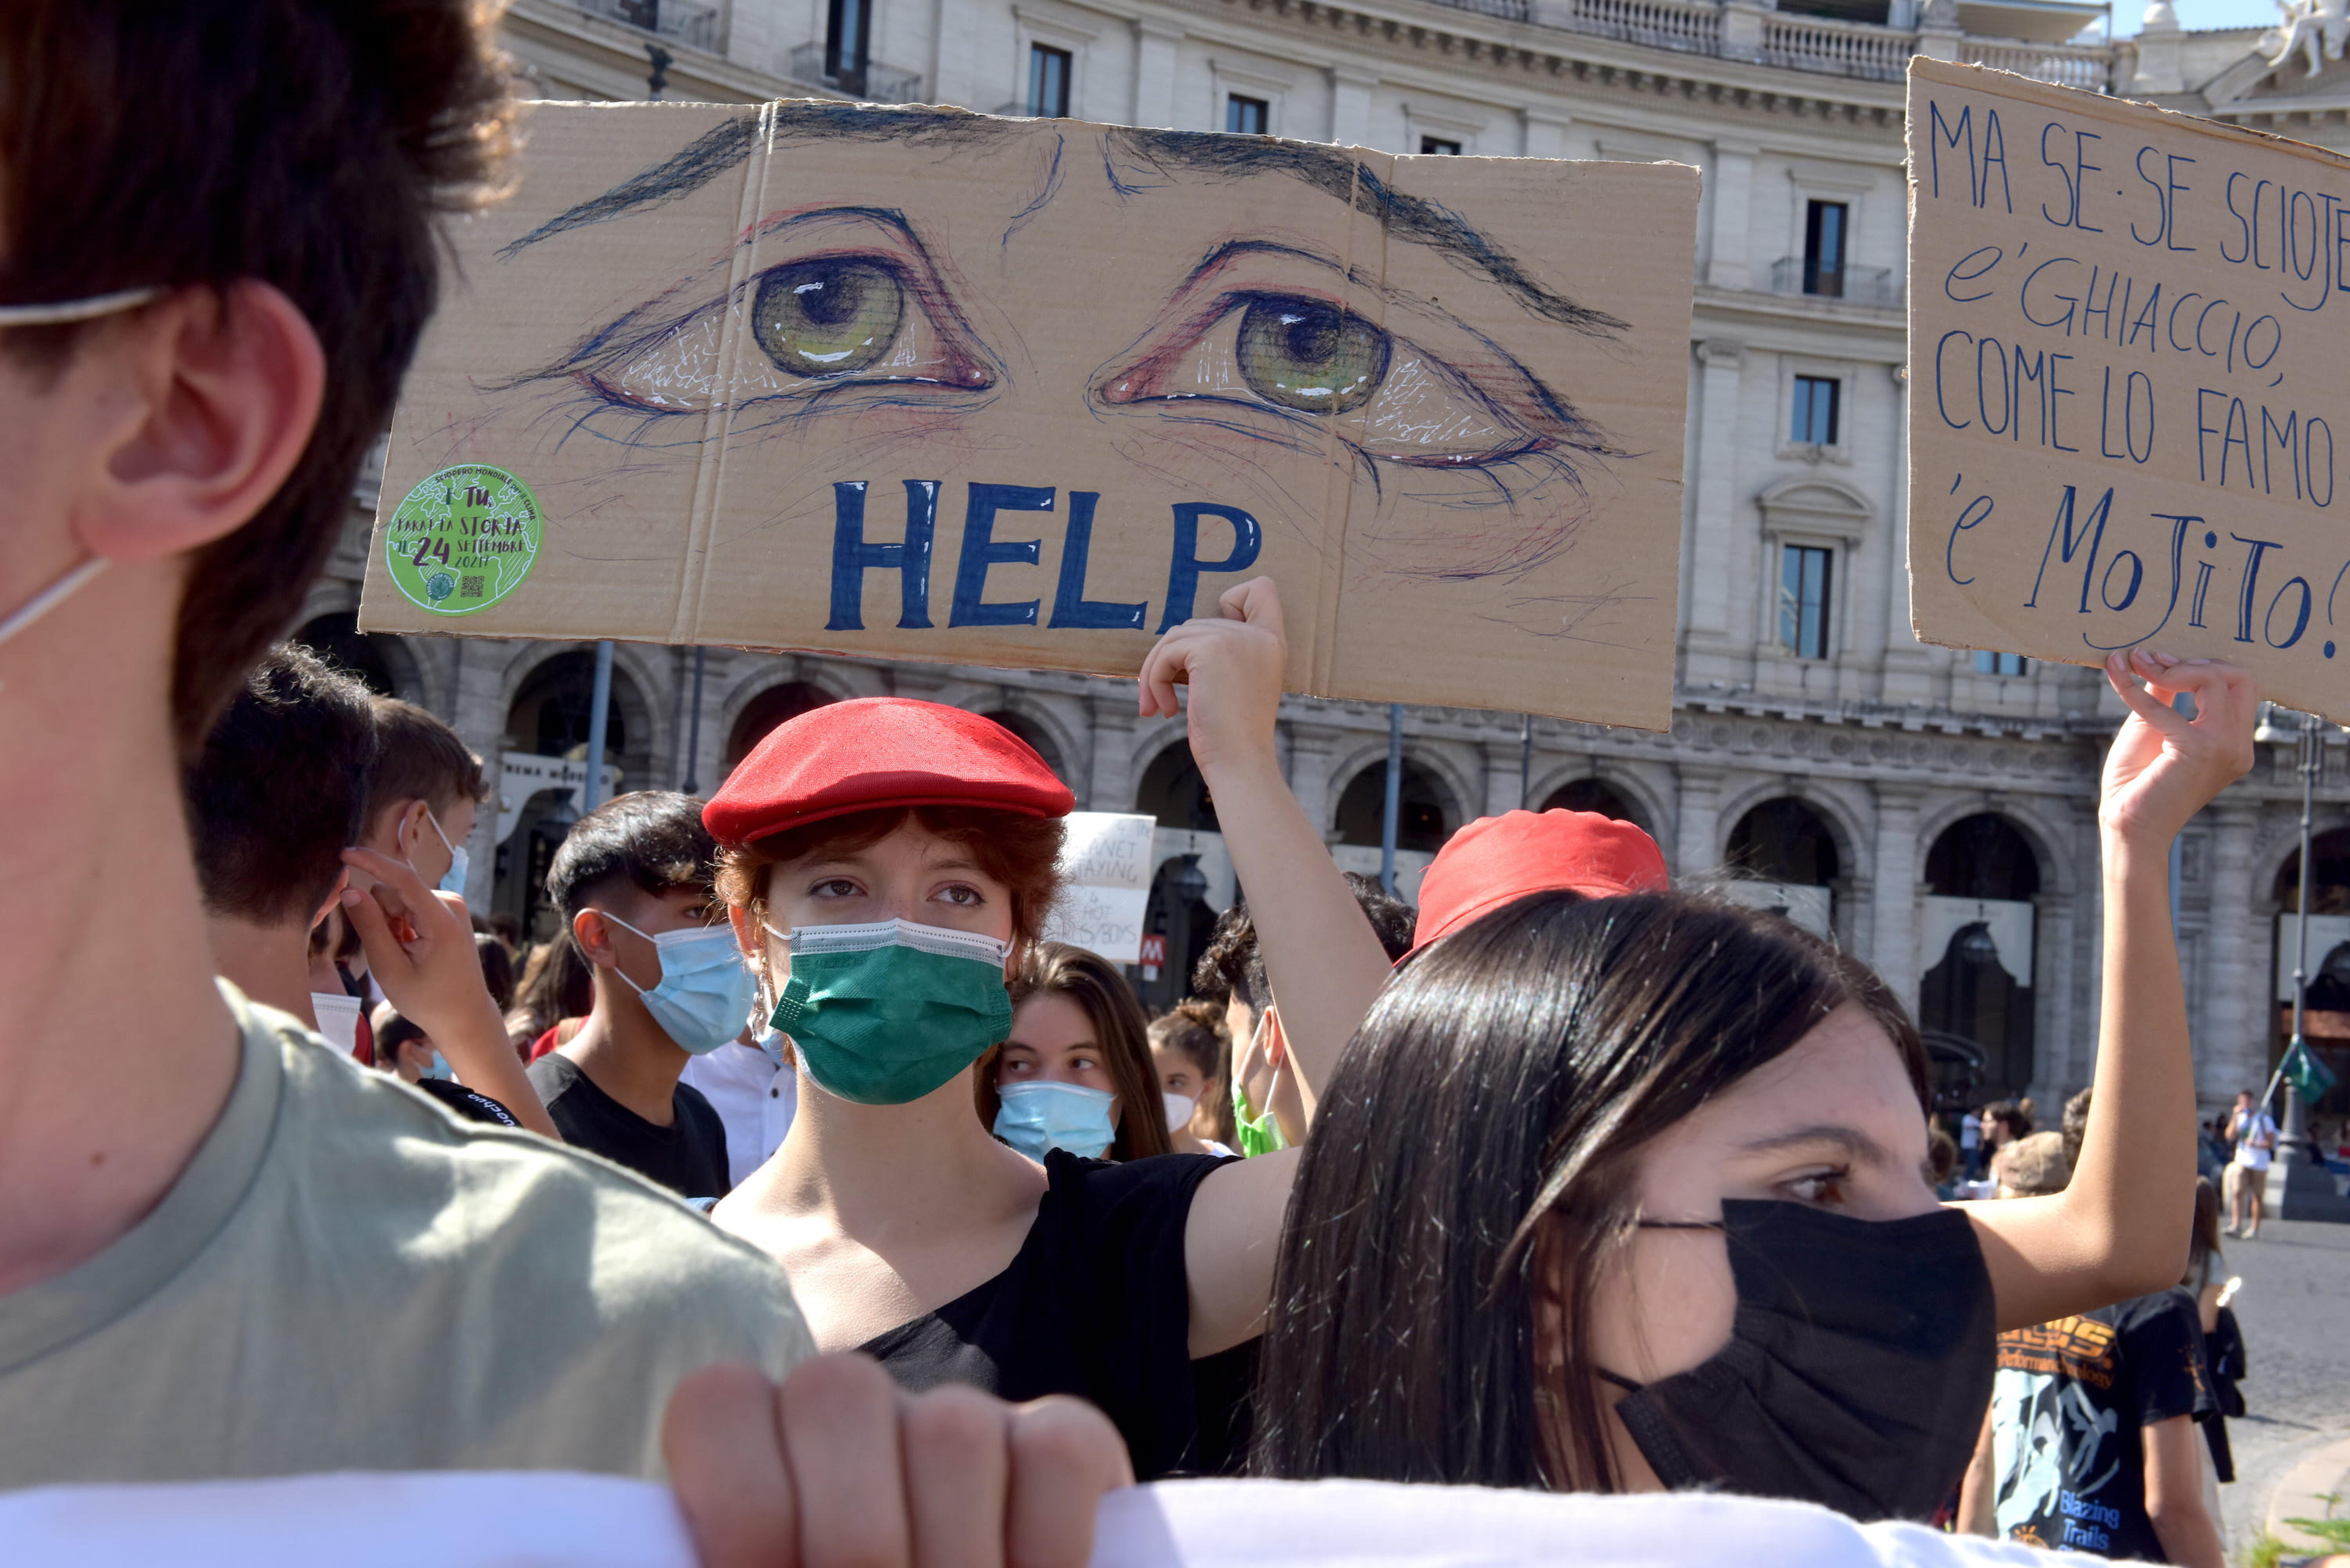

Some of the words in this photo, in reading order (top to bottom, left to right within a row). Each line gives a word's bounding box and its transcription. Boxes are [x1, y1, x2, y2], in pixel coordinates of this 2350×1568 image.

[1930, 100, 2012, 214] MA
[1936, 330, 2079, 452] COME
[2102, 365, 2155, 463] LO
[2198, 388, 2333, 507] FAMO
[435, 468, 473, 483] SCIOPERO
[475, 468, 512, 485] MONDIALE
[459, 516, 522, 537] STORIA
[412, 537, 450, 566] 24
[457, 539, 524, 554] SETTEMBRE
[824, 478, 1263, 635] HELP
[1142, 939, 1164, 961] M
[2060, 1489, 2120, 1529] Blazing
[2063, 1518, 2110, 1551] Trails
